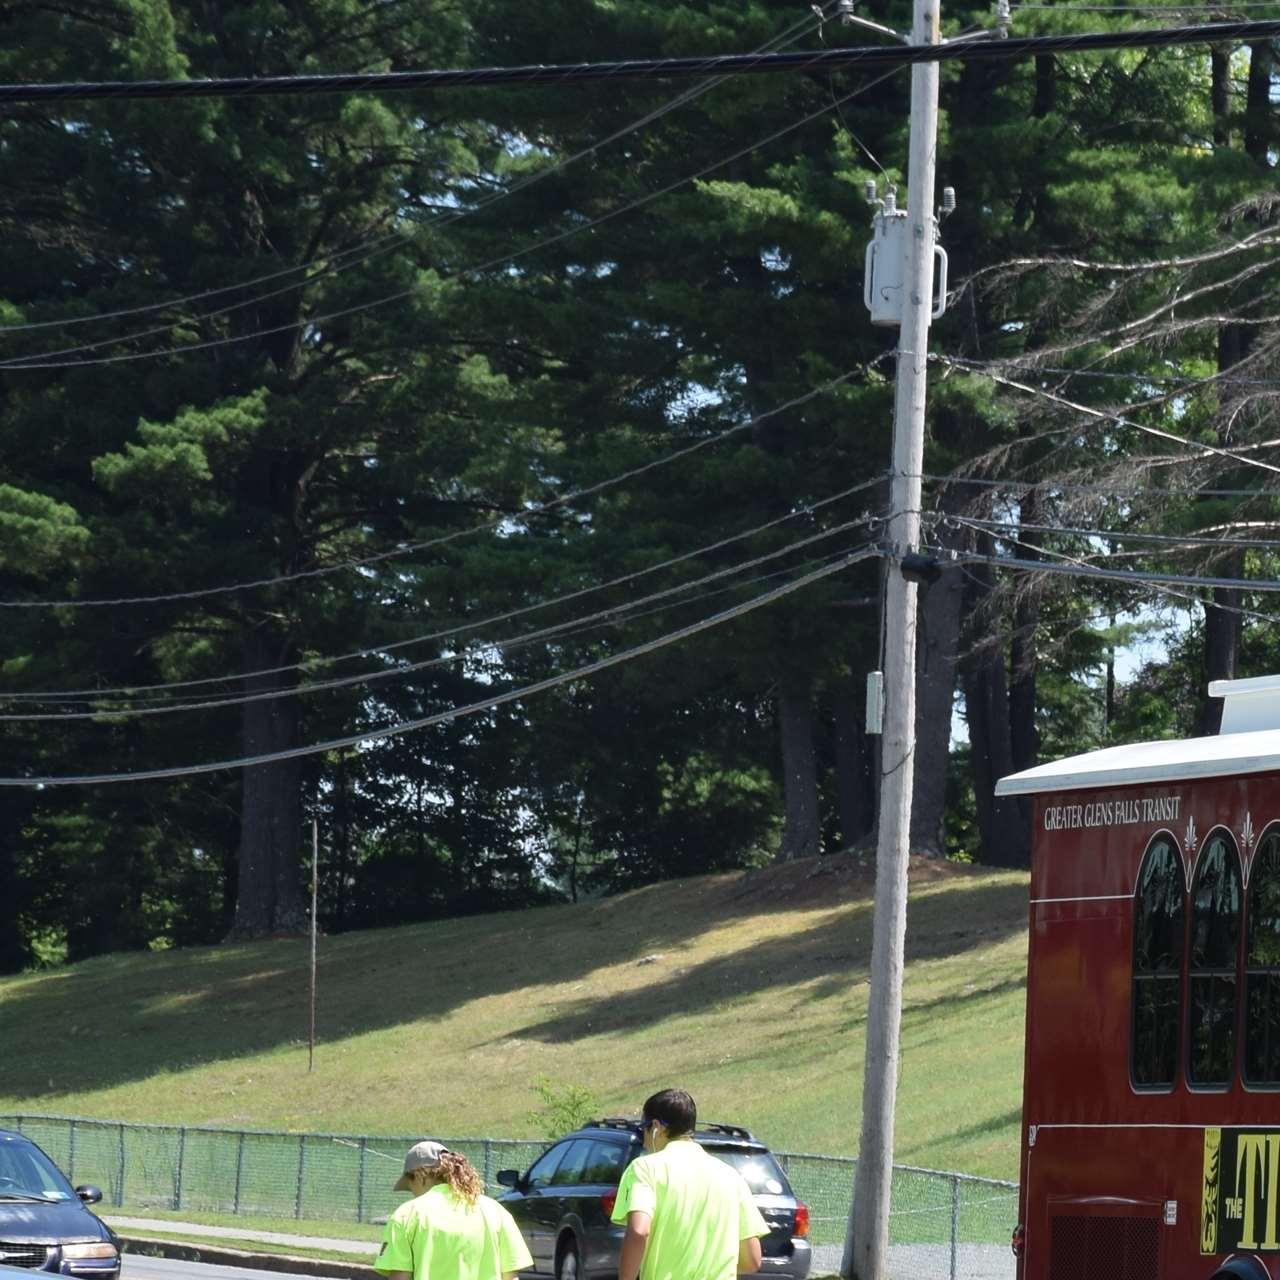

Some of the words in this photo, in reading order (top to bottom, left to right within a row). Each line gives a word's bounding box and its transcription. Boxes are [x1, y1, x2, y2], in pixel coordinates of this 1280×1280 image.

[1044, 806, 1083, 830] GREATER
[1085, 802, 1113, 827] GLENS
[1115, 800, 1140, 825] FALLS
[1142, 796, 1181, 821] TRANSIT
[1225, 1198, 1243, 1219] THE
